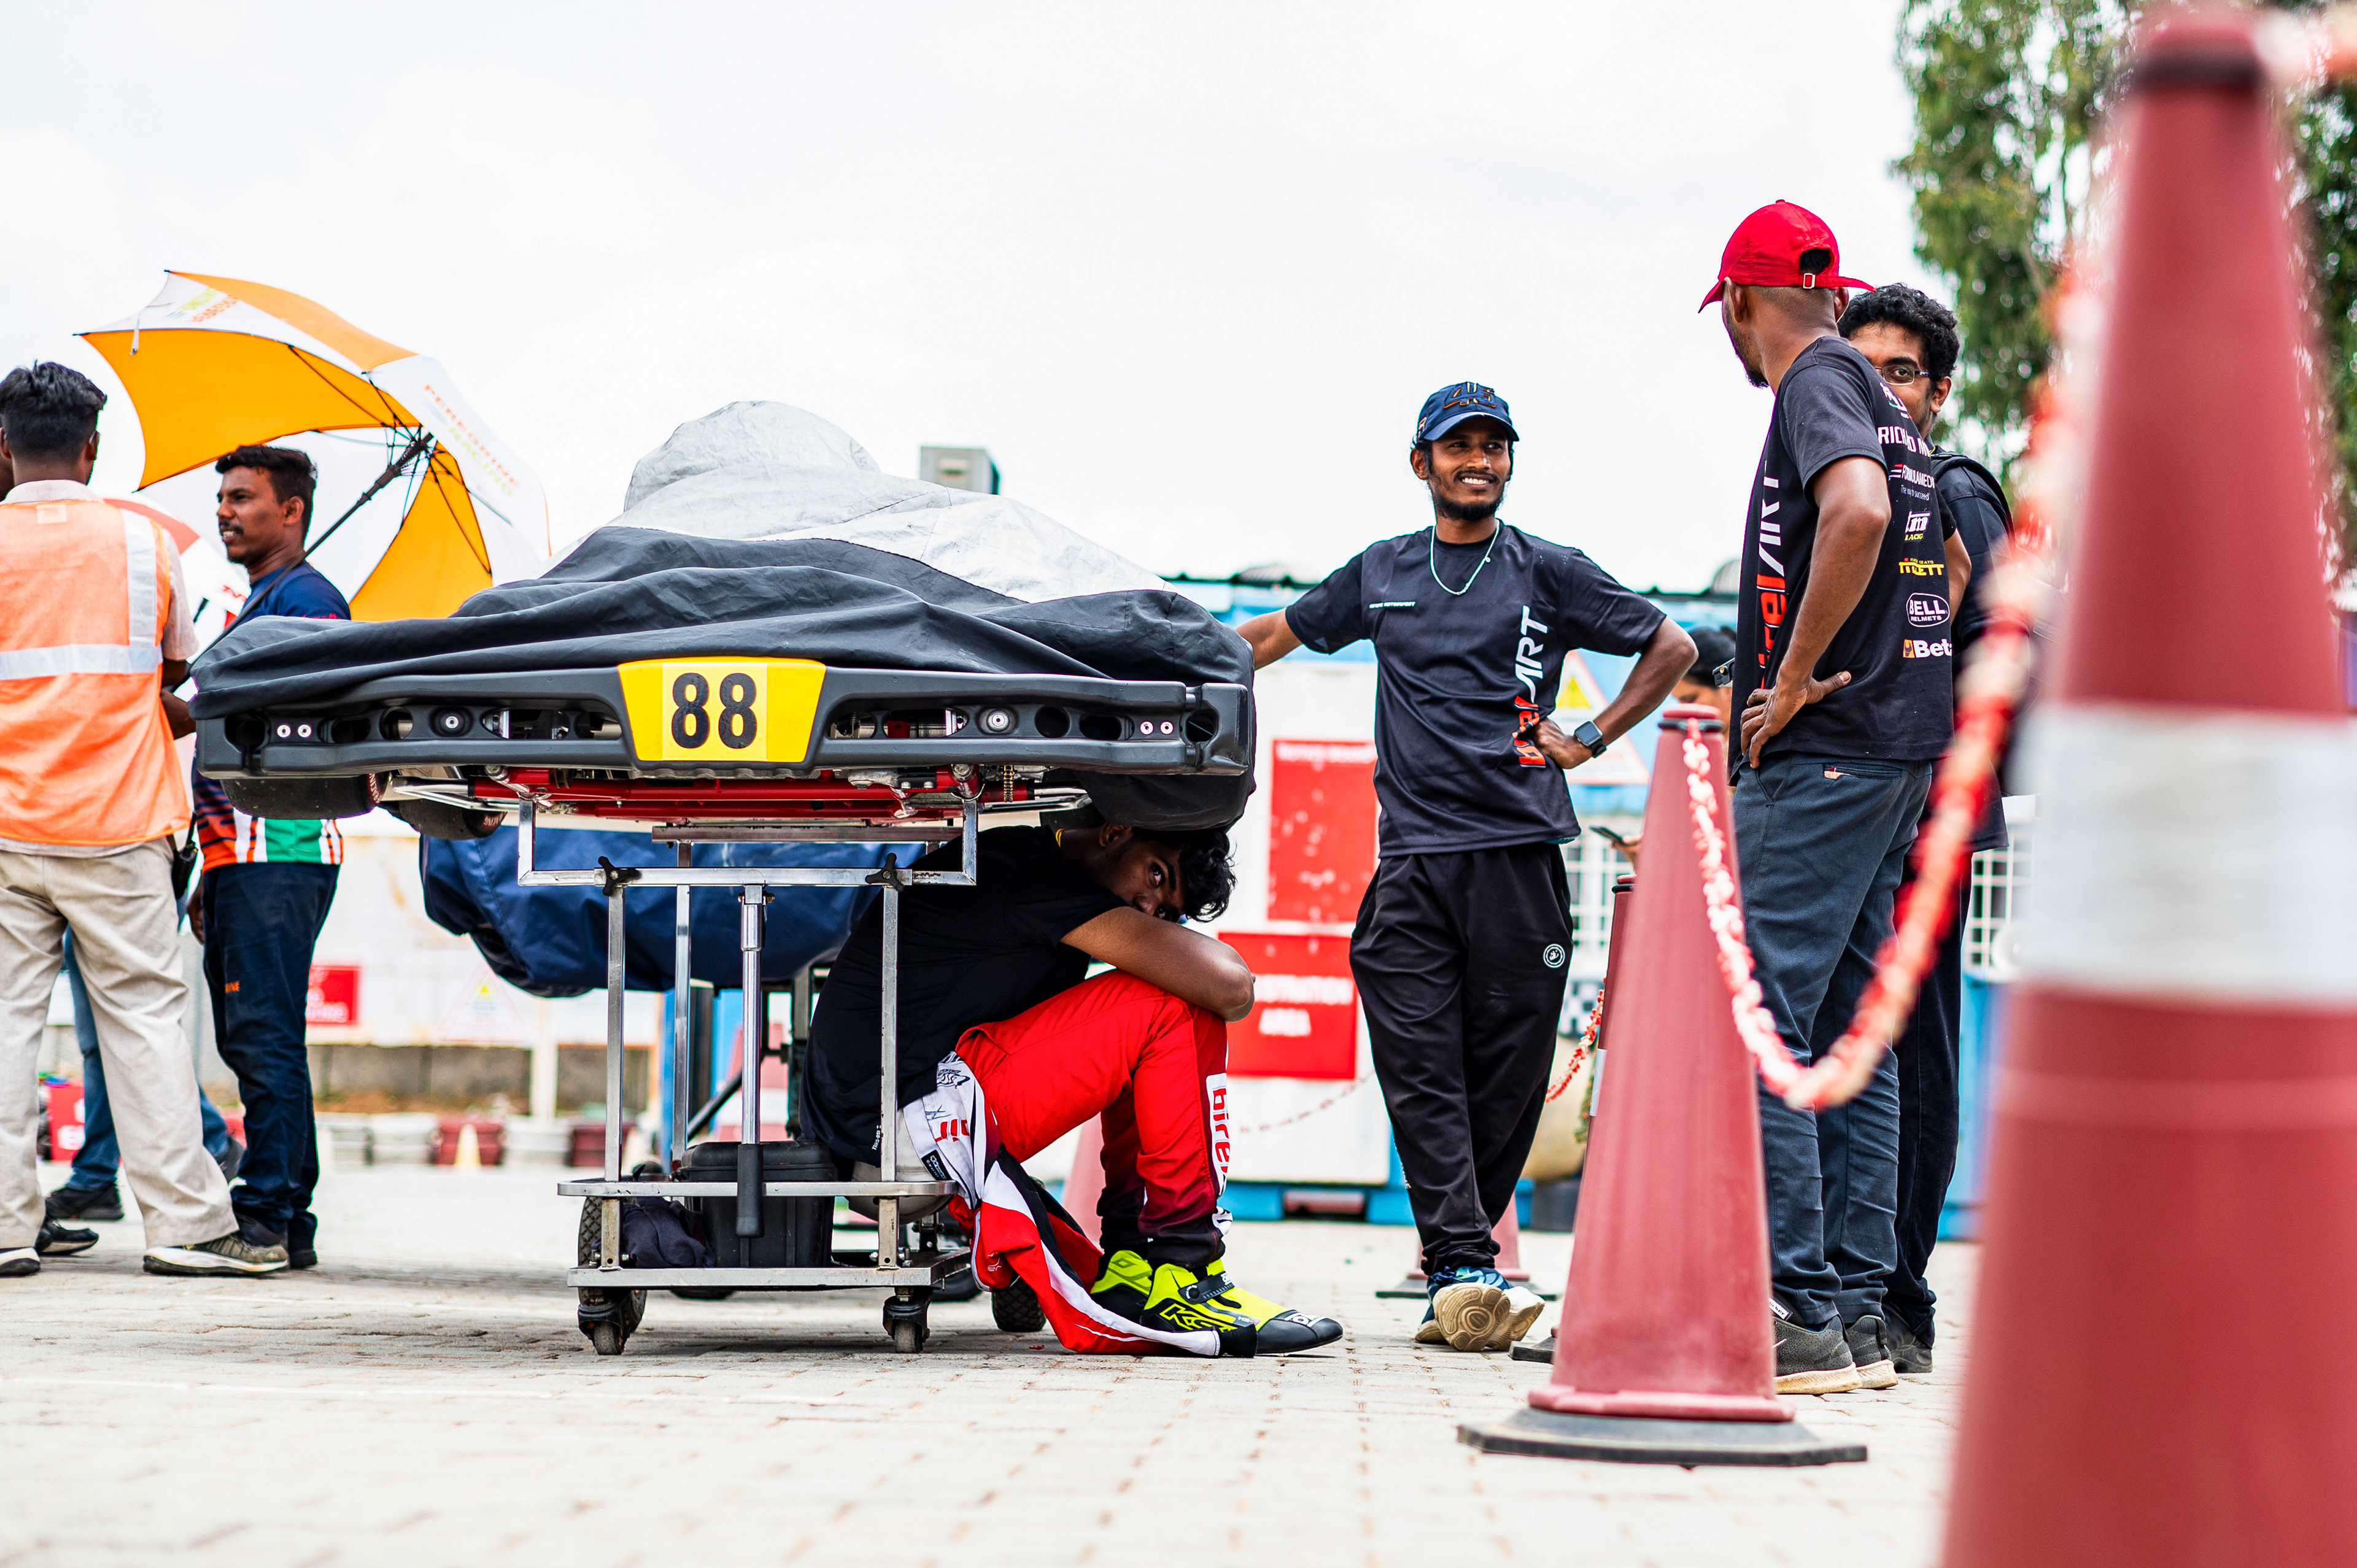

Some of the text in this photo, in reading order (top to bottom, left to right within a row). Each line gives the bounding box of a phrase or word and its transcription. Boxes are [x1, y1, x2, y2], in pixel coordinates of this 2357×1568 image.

[424, 384, 520, 489] PEREGRINE
[449, 427, 513, 496] RACING
[1909, 599, 1946, 615] BELL
[1515, 604, 1548, 704] ART
[671, 672, 757, 749] 88
